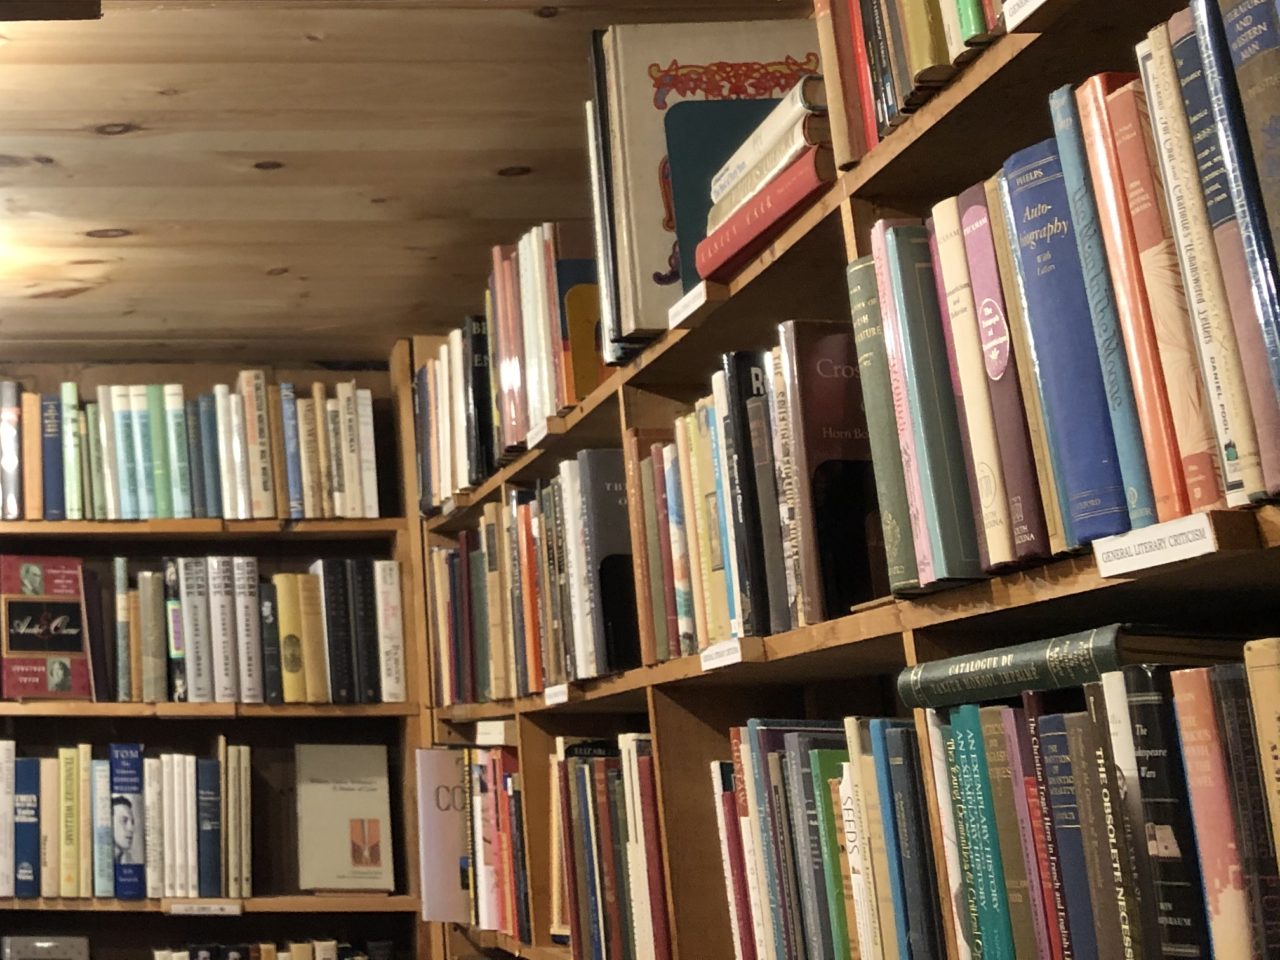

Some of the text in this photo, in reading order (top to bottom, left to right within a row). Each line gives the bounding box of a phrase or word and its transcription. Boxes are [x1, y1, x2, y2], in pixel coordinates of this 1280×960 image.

[1016, 169, 1043, 186] PHELPS
[1023, 203, 1052, 222] Auto-
[1205, 355, 1233, 435] DANIEL POOL
[1102, 528, 1207, 564] GENERAL LITERARY CRITICISM
[183, 560, 194, 597] WILDE
[194, 559, 206, 597] OSCAR
[221, 560, 232, 595] OSCAR
[245, 560, 256, 597] OSCAR
[948, 654, 1014, 676] CATALOGUE DU
[1135, 723, 1148, 738] The
[113, 750, 139, 758] TOM
[840, 795, 860, 855] SEEDS
[954, 729, 991, 912] AN EXEMPLARY HISTORY
[965, 728, 1002, 912] AN EXEMPLARY HISTORY
[1027, 716, 1071, 949] The Christian Tragic Hero in French and English
[1094, 746, 1122, 883] THE OBSOLETE
